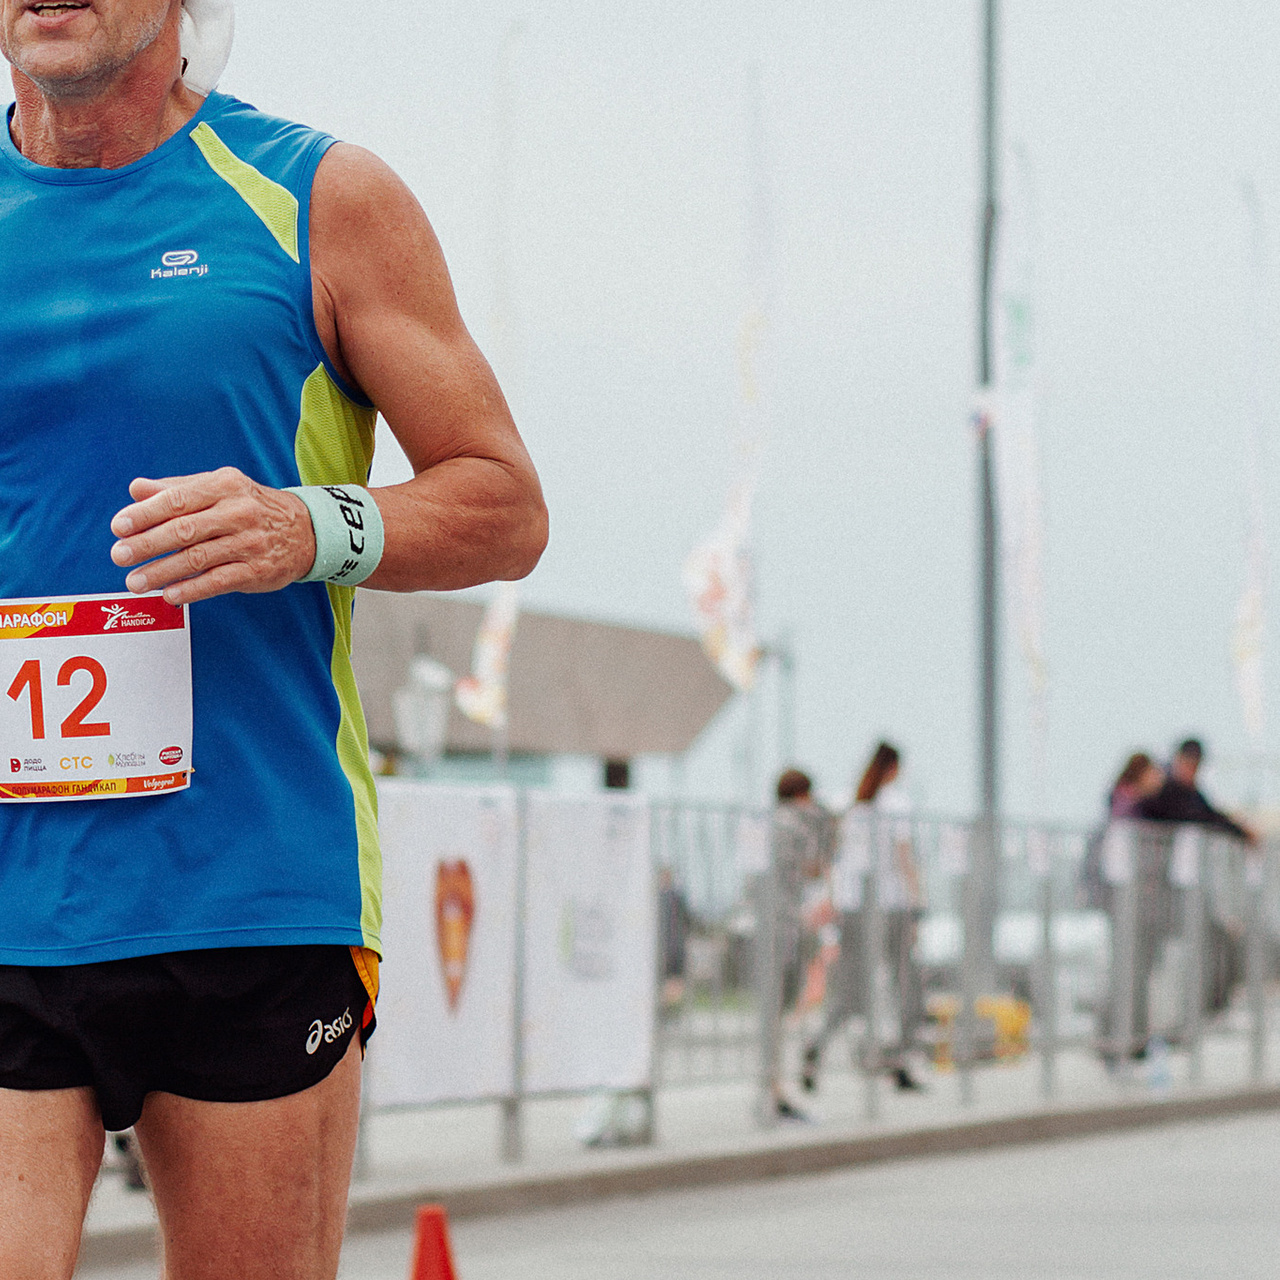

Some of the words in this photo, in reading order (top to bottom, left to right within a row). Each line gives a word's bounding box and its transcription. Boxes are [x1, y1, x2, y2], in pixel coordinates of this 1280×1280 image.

[121, 618, 156, 627] HANDICAP
[6, 655, 111, 740] 12
[12, 785, 69, 795] ПОЛУМАРАФОН
[72, 782, 117, 793] ГАНДИКАП
